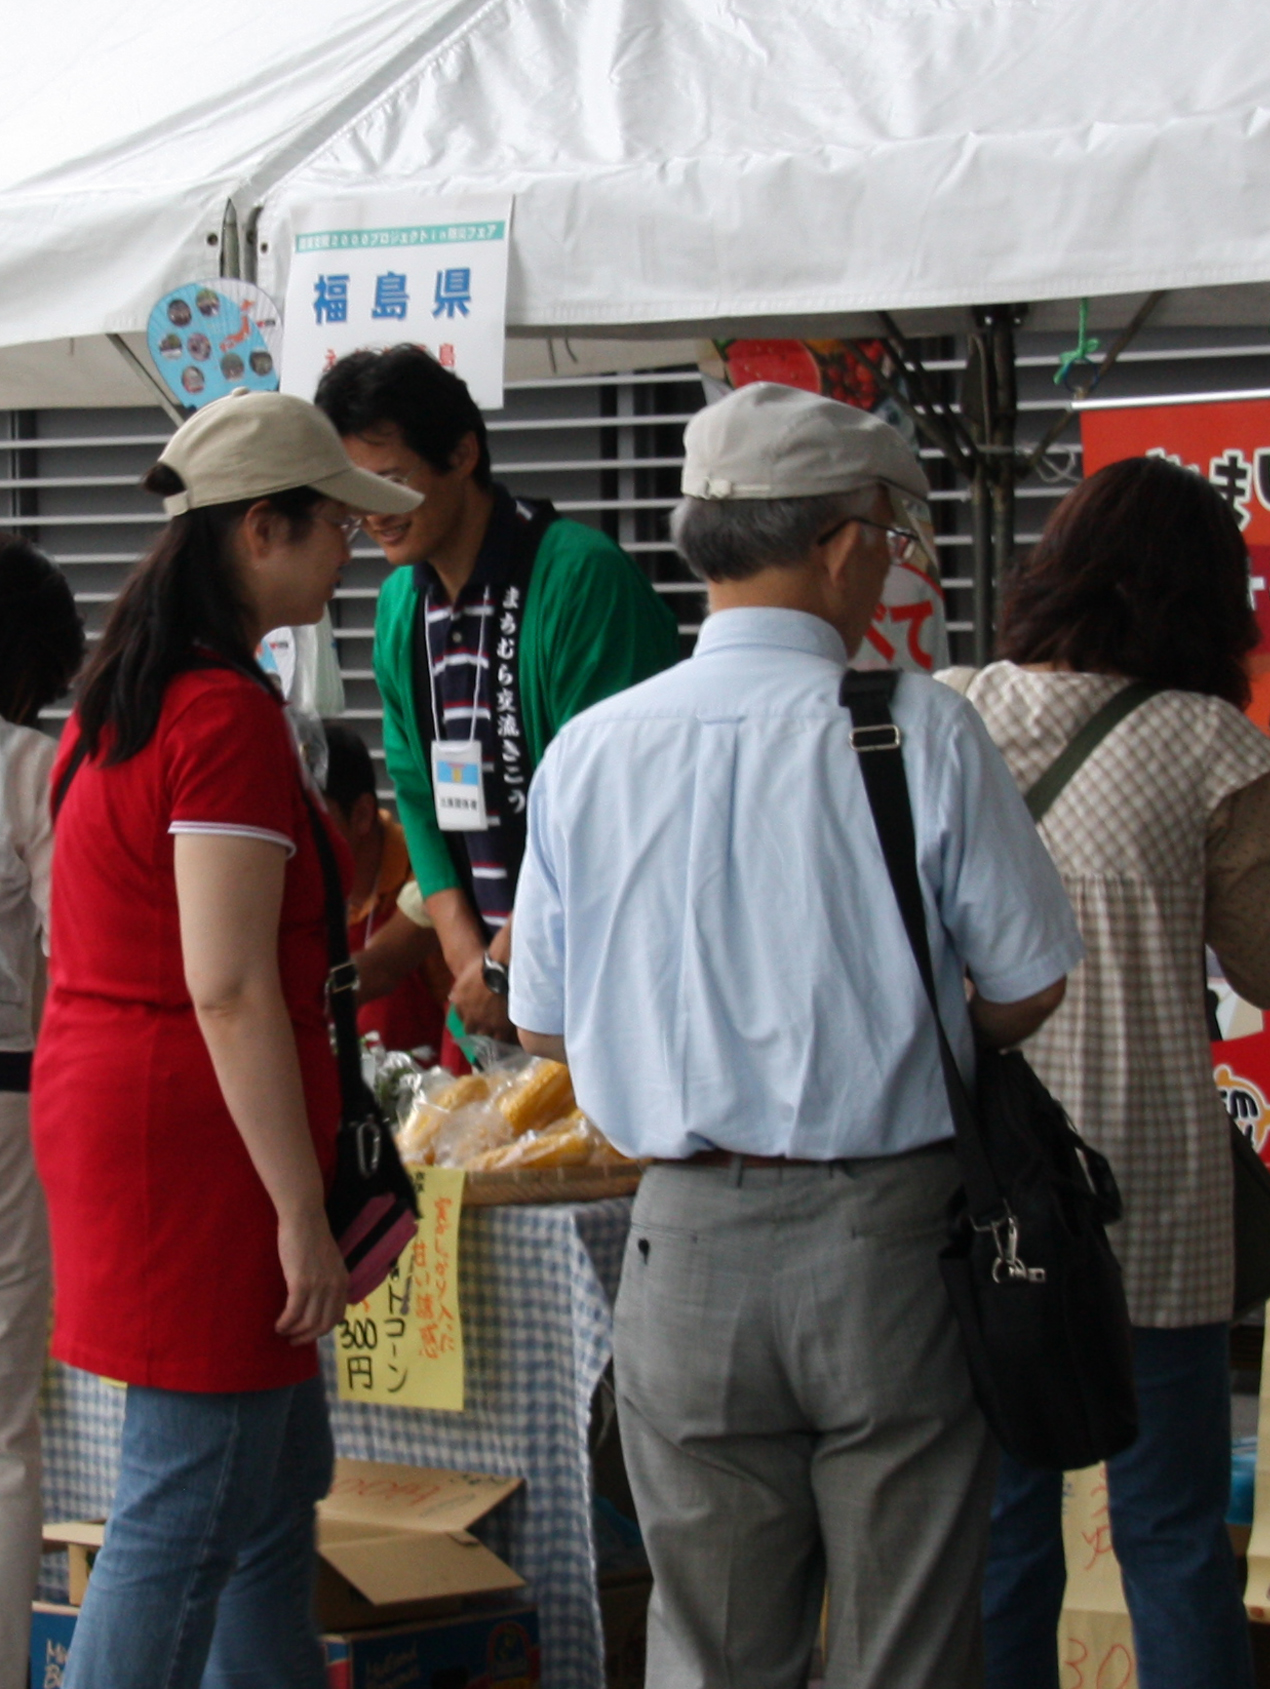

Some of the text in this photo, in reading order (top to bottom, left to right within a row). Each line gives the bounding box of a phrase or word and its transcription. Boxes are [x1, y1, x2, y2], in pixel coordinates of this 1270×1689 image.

[313, 267, 473, 325] 福島県
[338, 1317, 378, 1350] 300
[346, 1355, 374, 1391] 円
